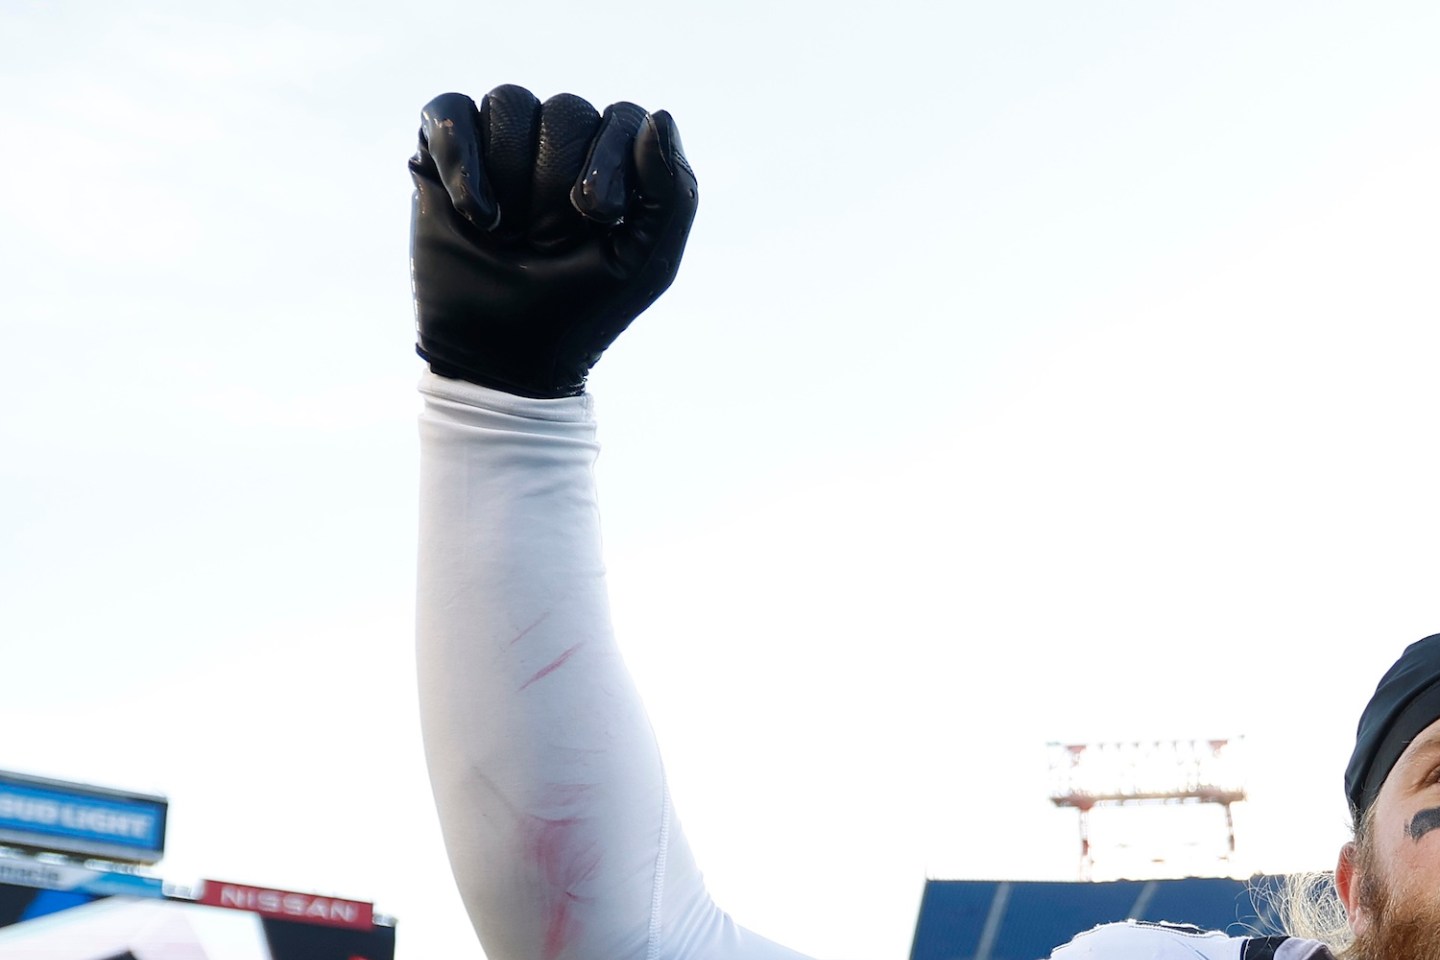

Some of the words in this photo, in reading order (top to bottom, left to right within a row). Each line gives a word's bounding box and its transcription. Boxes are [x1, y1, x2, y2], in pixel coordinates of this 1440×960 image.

[0, 793, 59, 825] BUD
[61, 803, 150, 839] LIGHT
[220, 885, 358, 922] NISSAN
